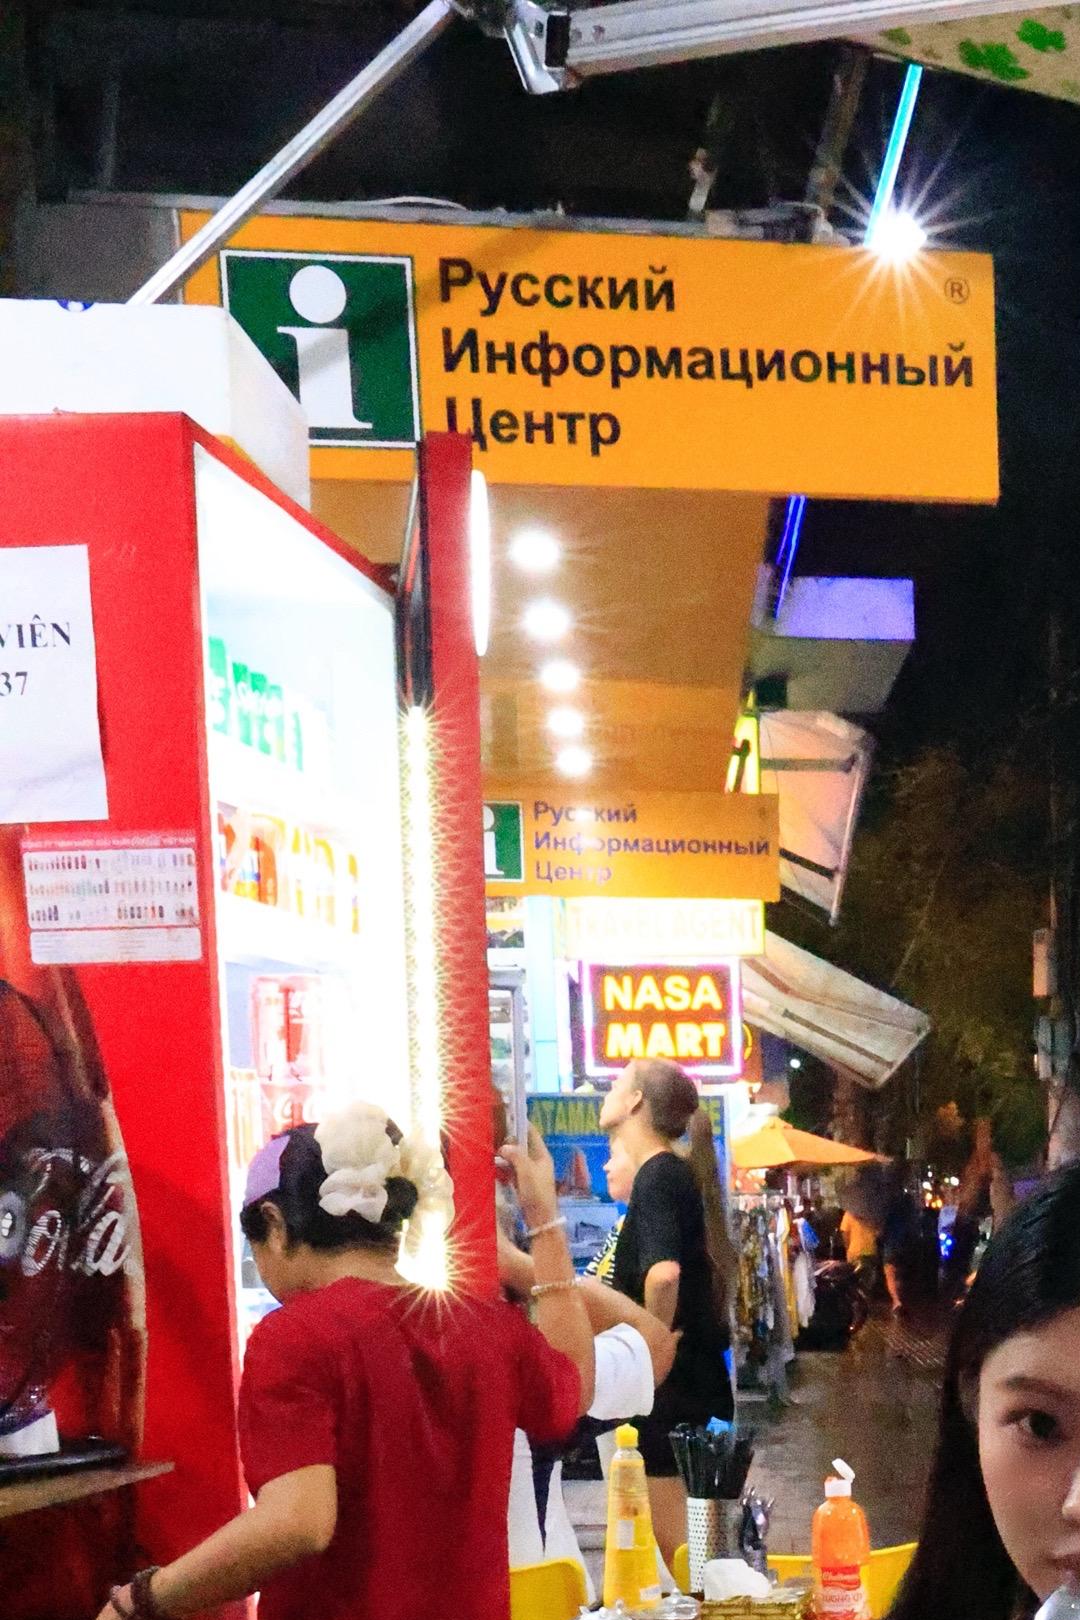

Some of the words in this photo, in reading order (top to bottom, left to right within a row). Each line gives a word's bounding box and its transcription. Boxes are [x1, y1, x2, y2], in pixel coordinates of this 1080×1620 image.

[440, 258, 676, 314] Русский
[442, 328, 975, 388] Информационный
[446, 397, 622, 455] Центр
[533, 801, 638, 825] Руский
[603, 974, 723, 1011] NASA
[605, 1022, 726, 1059] MART
